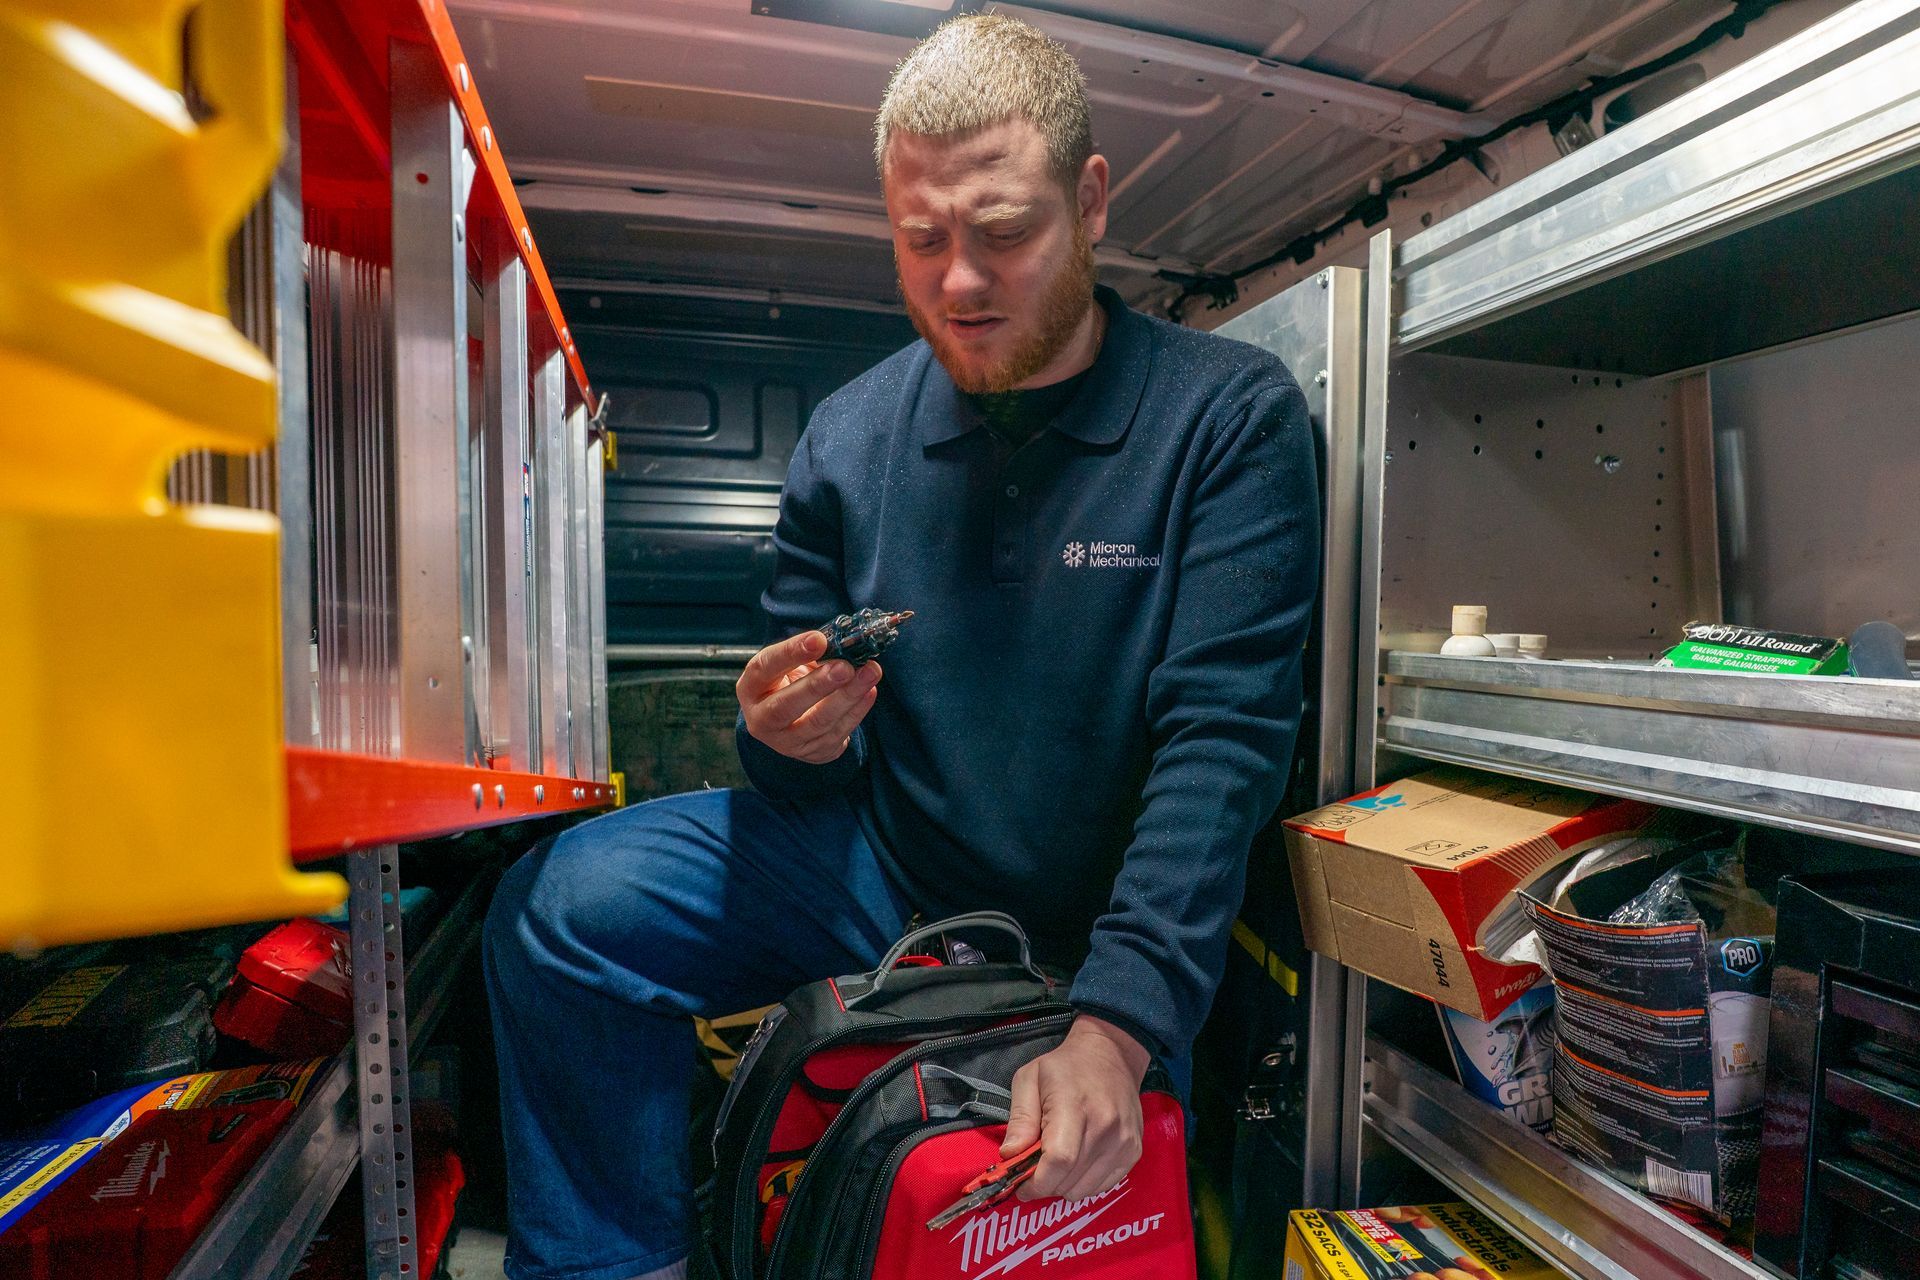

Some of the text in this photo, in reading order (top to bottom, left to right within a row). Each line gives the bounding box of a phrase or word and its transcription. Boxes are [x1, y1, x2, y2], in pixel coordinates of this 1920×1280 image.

[1090, 540, 1136, 555] Micron
[1089, 553, 1161, 567] Mechanical
[1736, 633, 1763, 648] All
[1761, 637, 1817, 654] Round
[1690, 645, 1798, 667] GALVANIZED STRAPPING
[1691, 653, 1724, 665] BANDE
[1428, 938, 1450, 988] 47044
[1728, 946, 1757, 967] PRO
[1299, 1211, 1325, 1229] 32
[1312, 1230, 1342, 1257] SACS
[1346, 1210, 1373, 1228] TRUE
[1365, 1227, 1387, 1241] TIE
[1041, 1213, 1165, 1267] PACKOUT
[1428, 1205, 1512, 1272] Industriels
